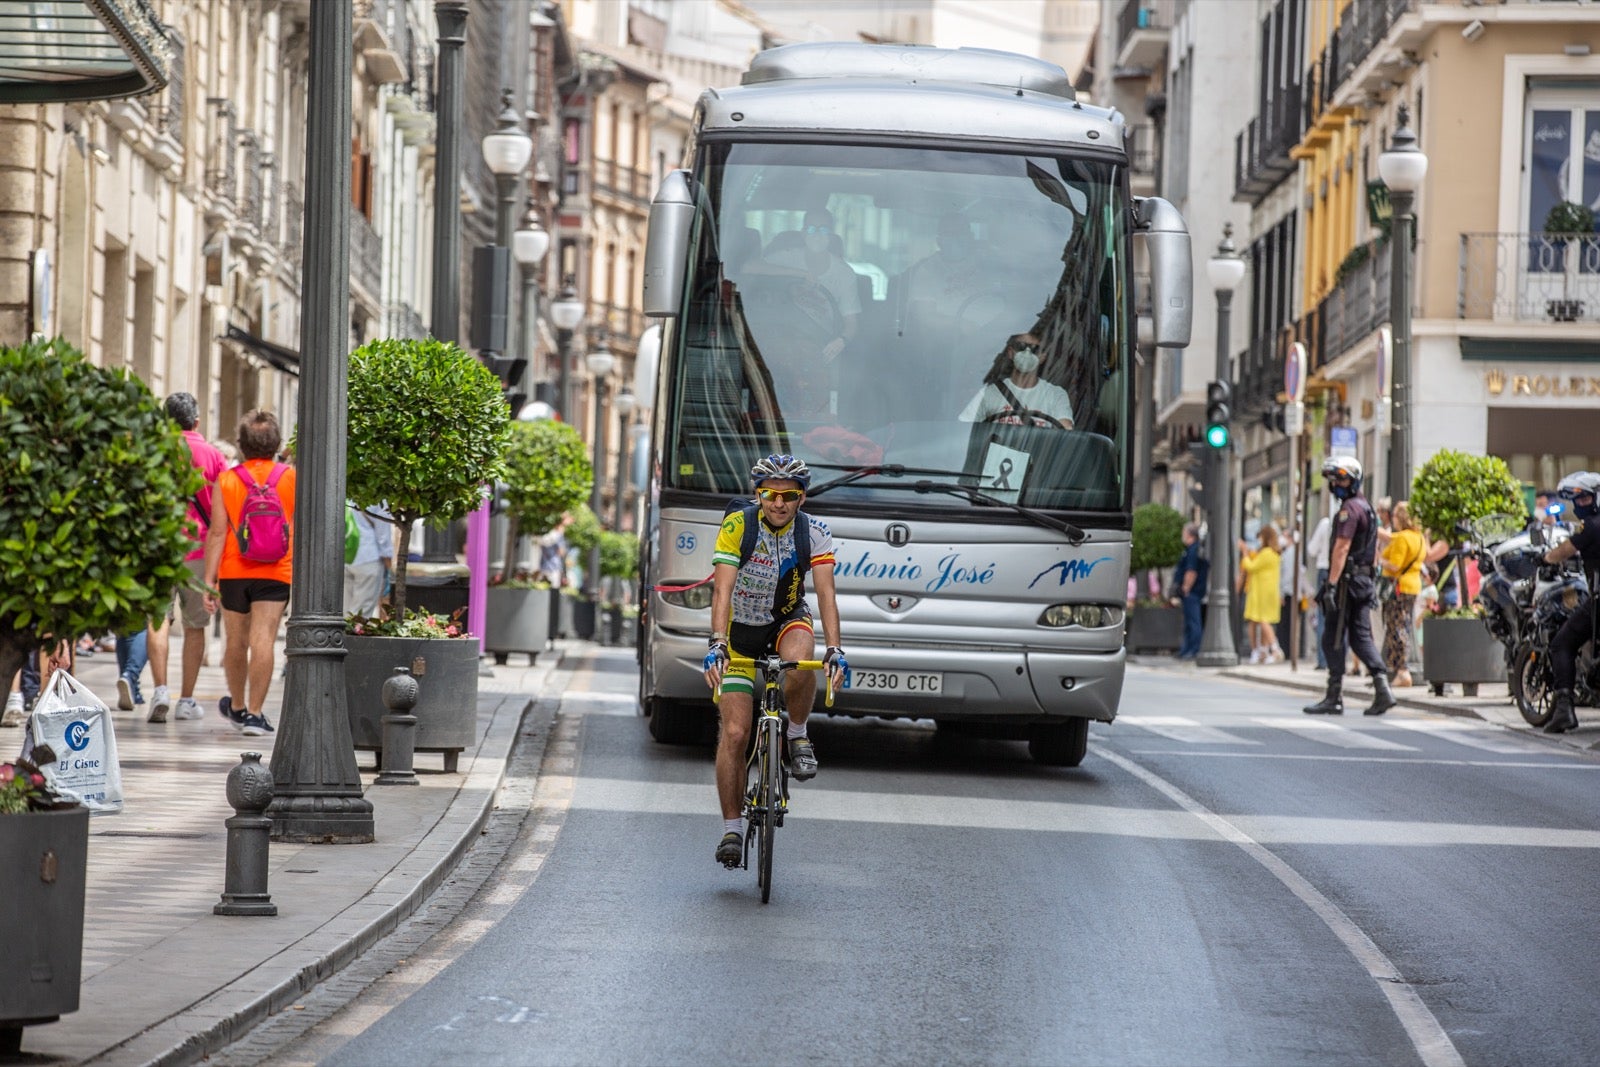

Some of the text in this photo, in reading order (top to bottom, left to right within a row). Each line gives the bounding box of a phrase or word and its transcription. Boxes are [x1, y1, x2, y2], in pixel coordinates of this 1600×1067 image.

[678, 536, 694, 550] 35
[833, 548, 996, 593] ntonio José
[856, 672, 938, 691] 7330 CTC
[60, 759, 100, 771] El Cisne
